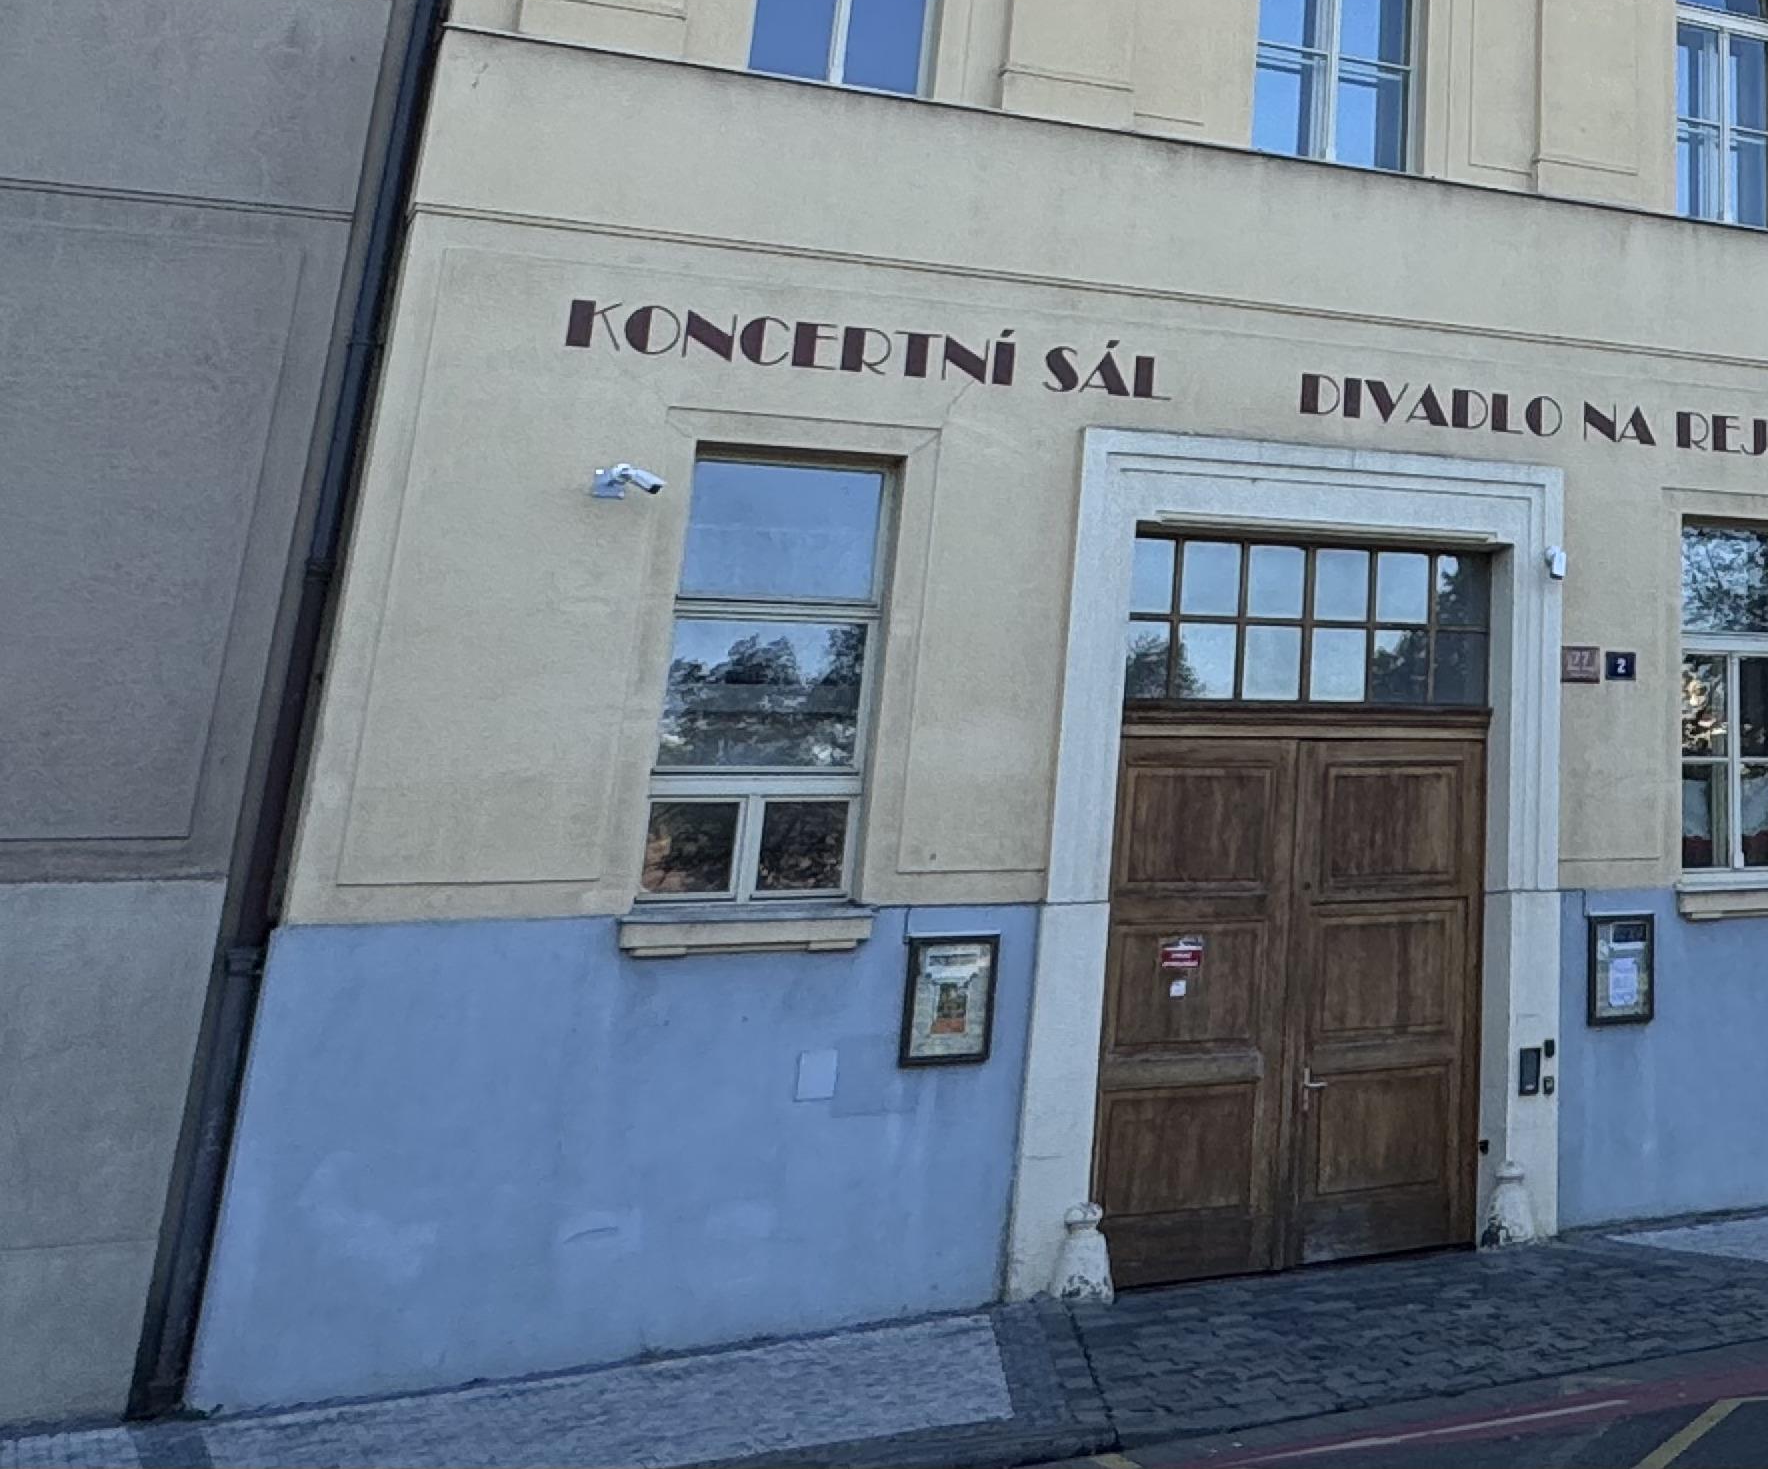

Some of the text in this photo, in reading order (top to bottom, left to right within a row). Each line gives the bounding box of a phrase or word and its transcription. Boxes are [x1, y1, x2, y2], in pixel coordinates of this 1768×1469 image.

[564, 298, 1172, 402] KONCERTNÍ SÁL
[1299, 372, 1563, 438] DIVADLO
[1583, 400, 1657, 447] NA
[1616, 657, 1626, 674] 2
